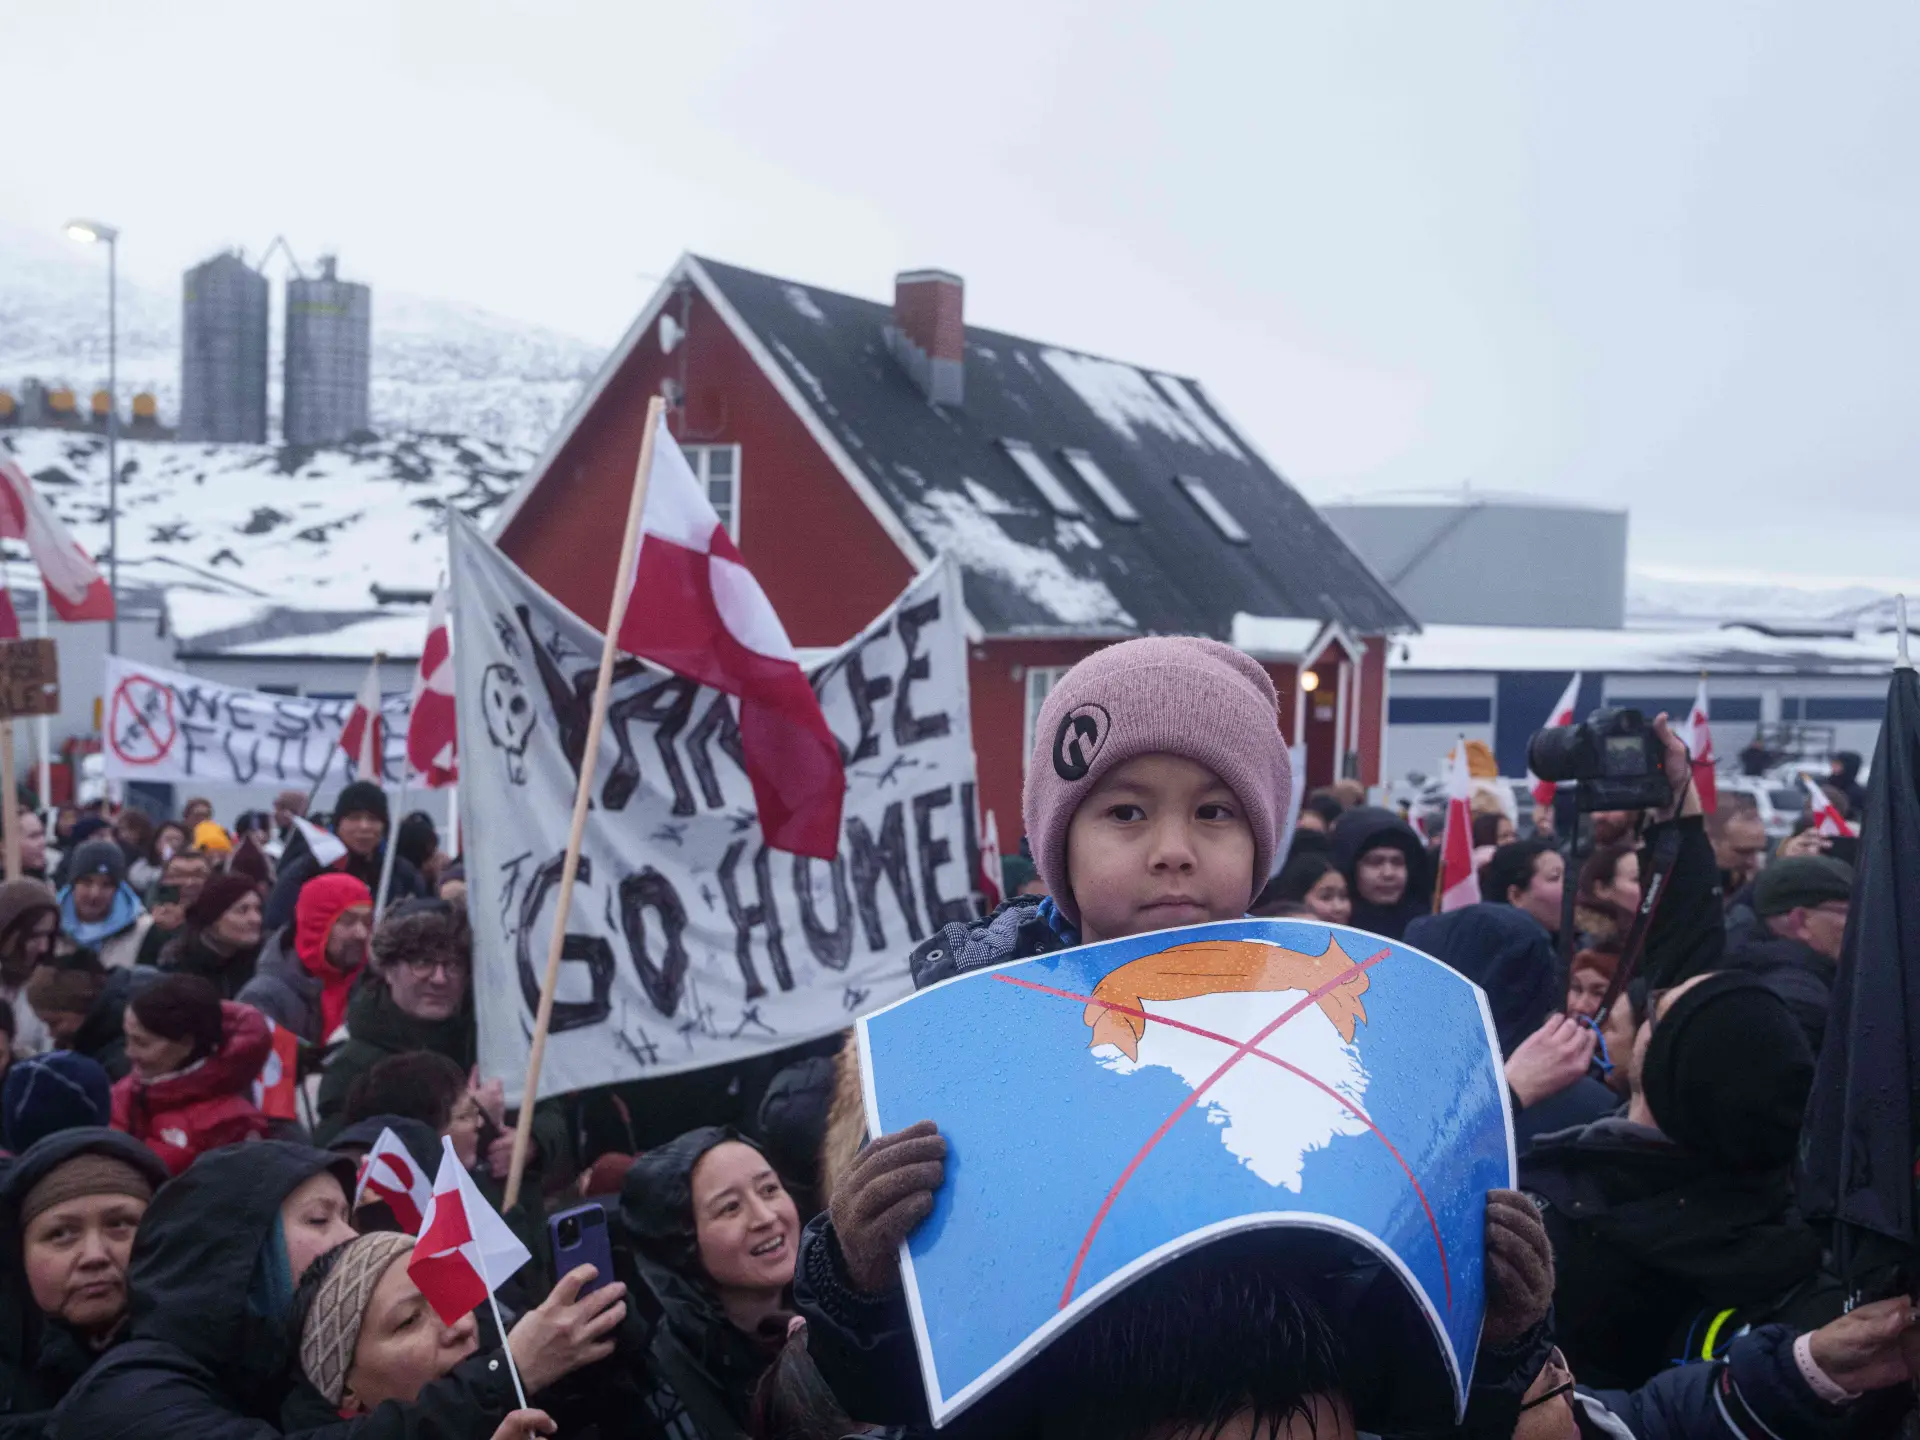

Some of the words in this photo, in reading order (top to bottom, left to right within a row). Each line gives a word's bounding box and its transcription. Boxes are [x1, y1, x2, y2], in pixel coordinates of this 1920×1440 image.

[169, 684, 256, 731] WE
[179, 722, 414, 786] FUTUE
[515, 594, 951, 817] YANEE
[516, 848, 689, 1035] GO
